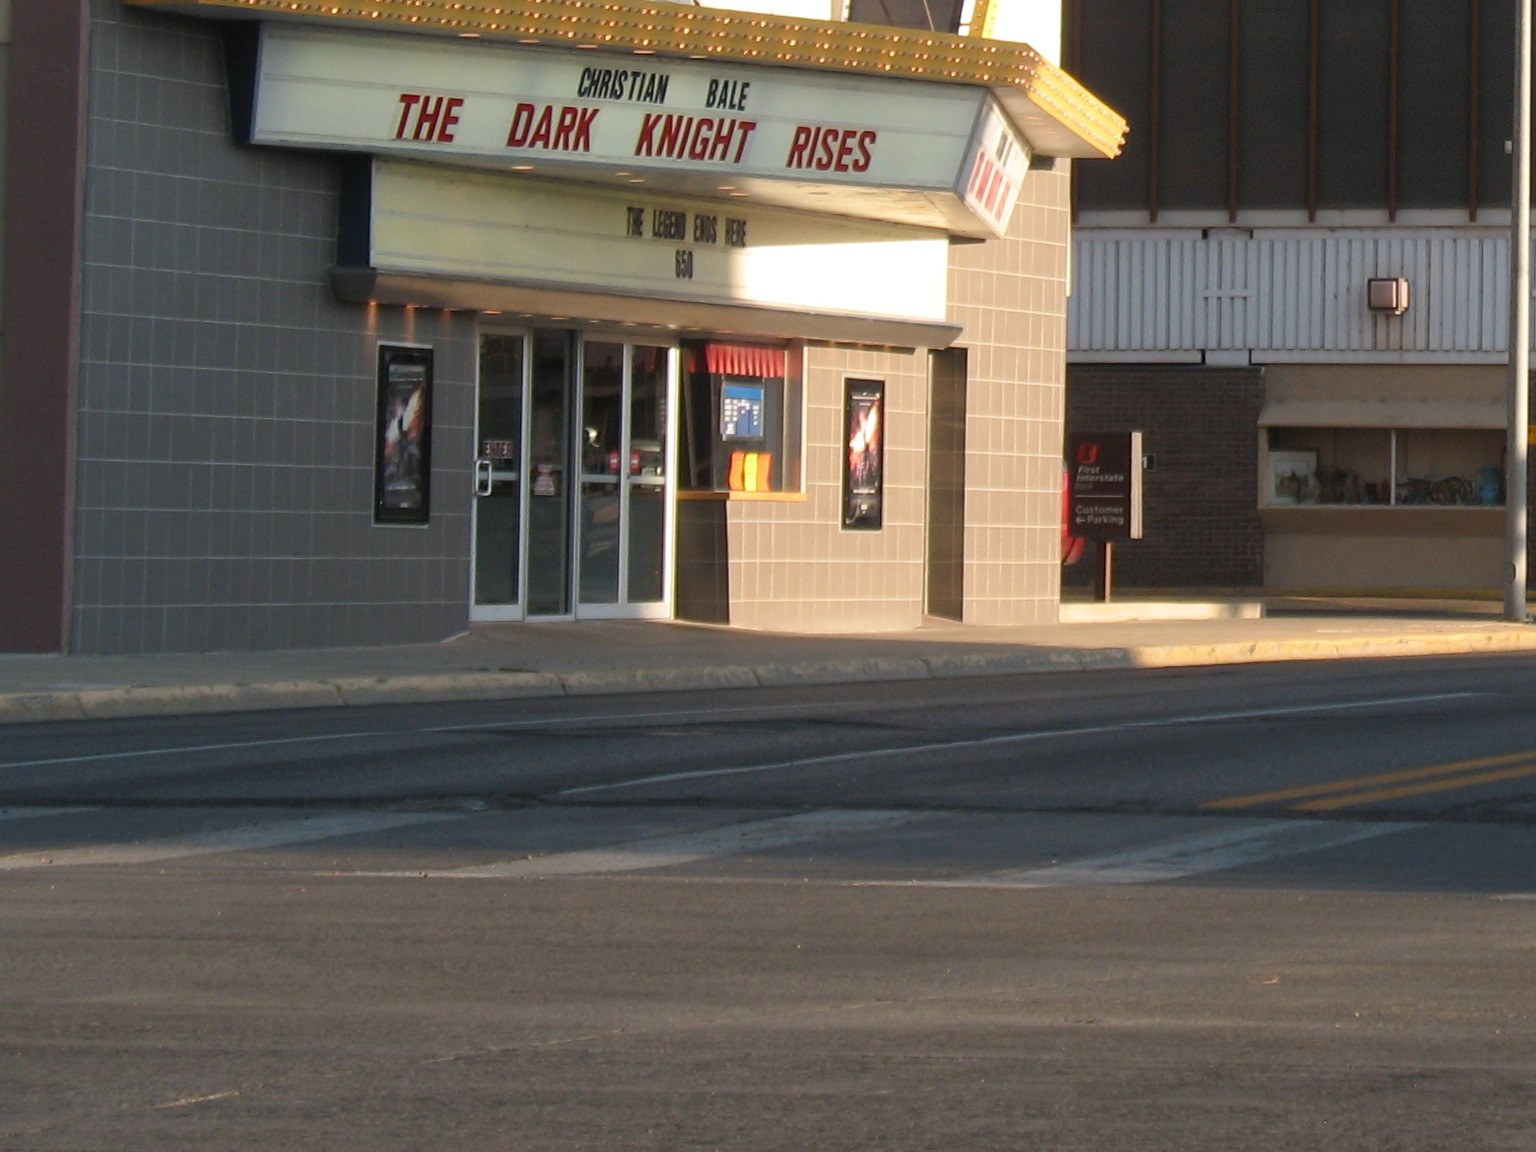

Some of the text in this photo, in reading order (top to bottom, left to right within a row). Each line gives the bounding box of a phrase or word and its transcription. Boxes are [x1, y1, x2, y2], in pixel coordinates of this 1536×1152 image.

[577, 66, 750, 112] CHRISTIAN BALE
[395, 93, 876, 173] THE DARK KNIGHT RISES
[626, 206, 748, 248] THE LEGEND ENDS HERE
[1077, 466, 1100, 474] First
[1076, 474, 1124, 482] Interstate
[1075, 505, 1124, 515] Customer
[1087, 515, 1124, 526] Parking
